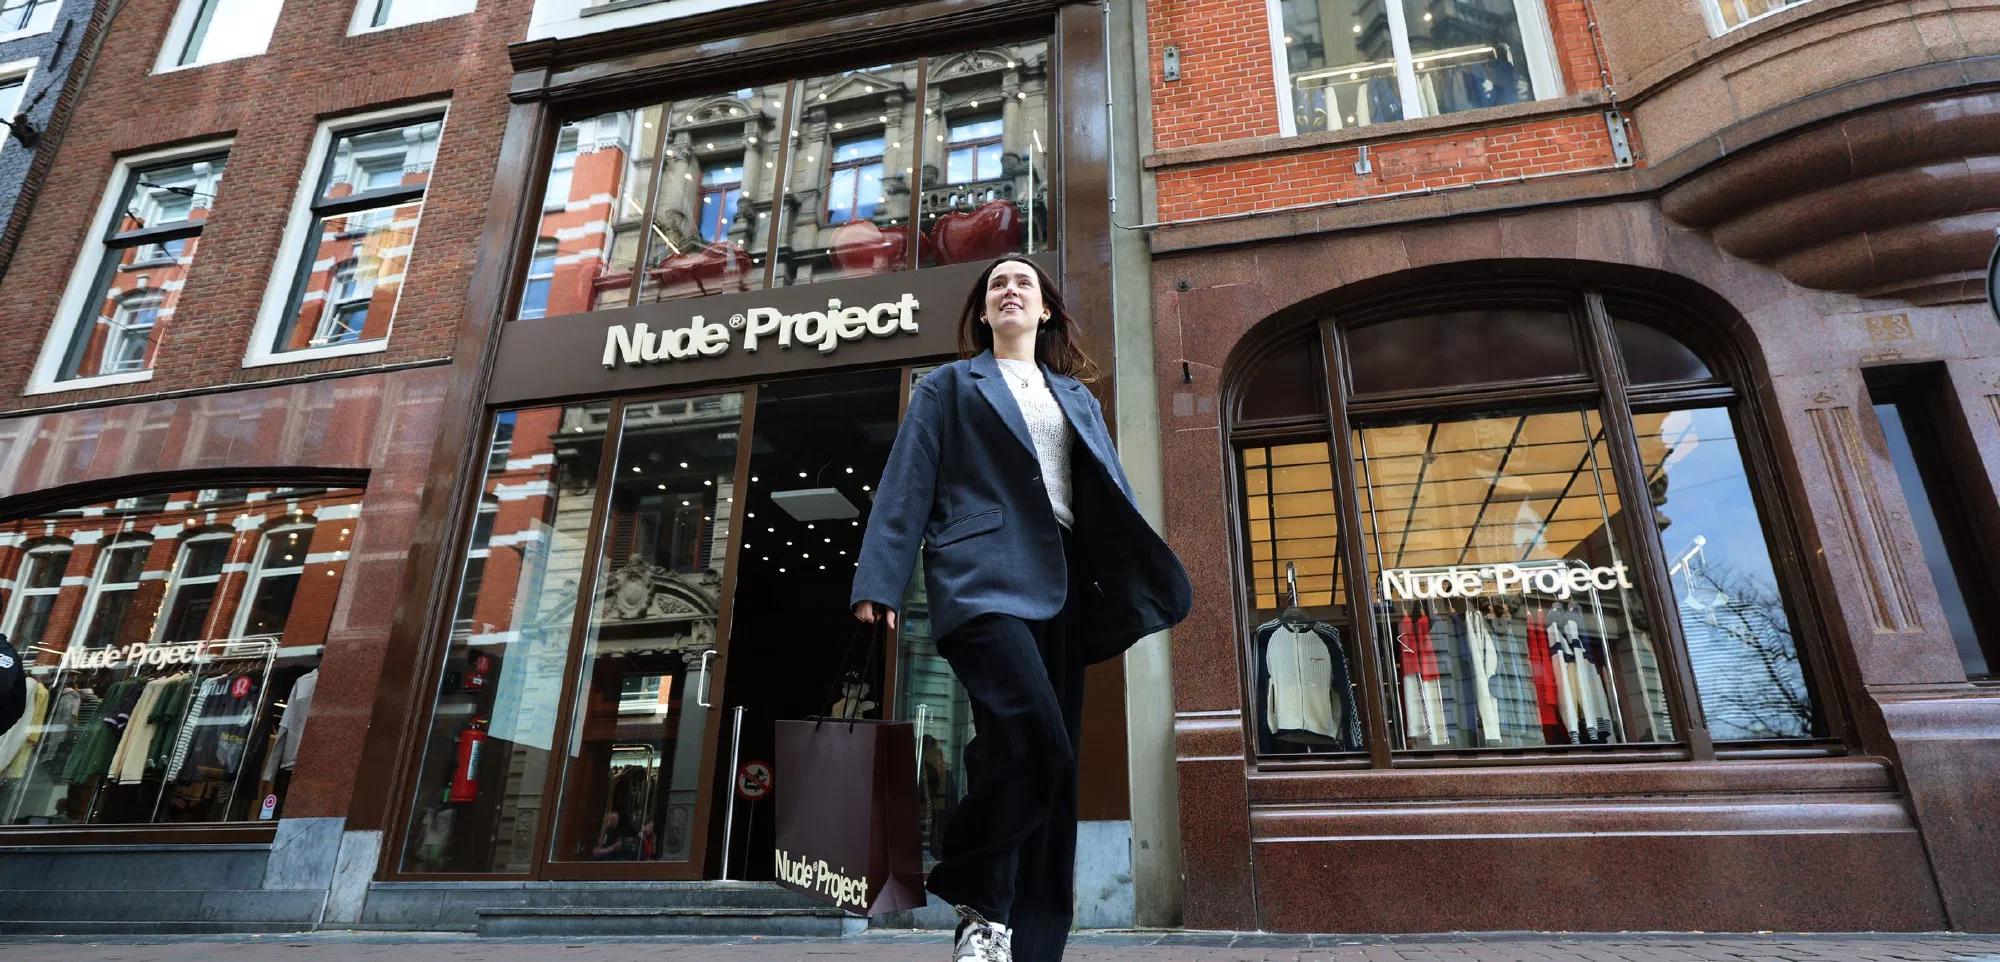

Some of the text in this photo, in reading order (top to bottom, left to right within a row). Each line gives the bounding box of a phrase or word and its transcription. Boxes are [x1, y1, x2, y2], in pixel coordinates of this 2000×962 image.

[743, 293, 920, 355] Project
[1493, 560, 1633, 600] Project
[126, 641, 208, 670] Project
[816, 860, 868, 908] Project
